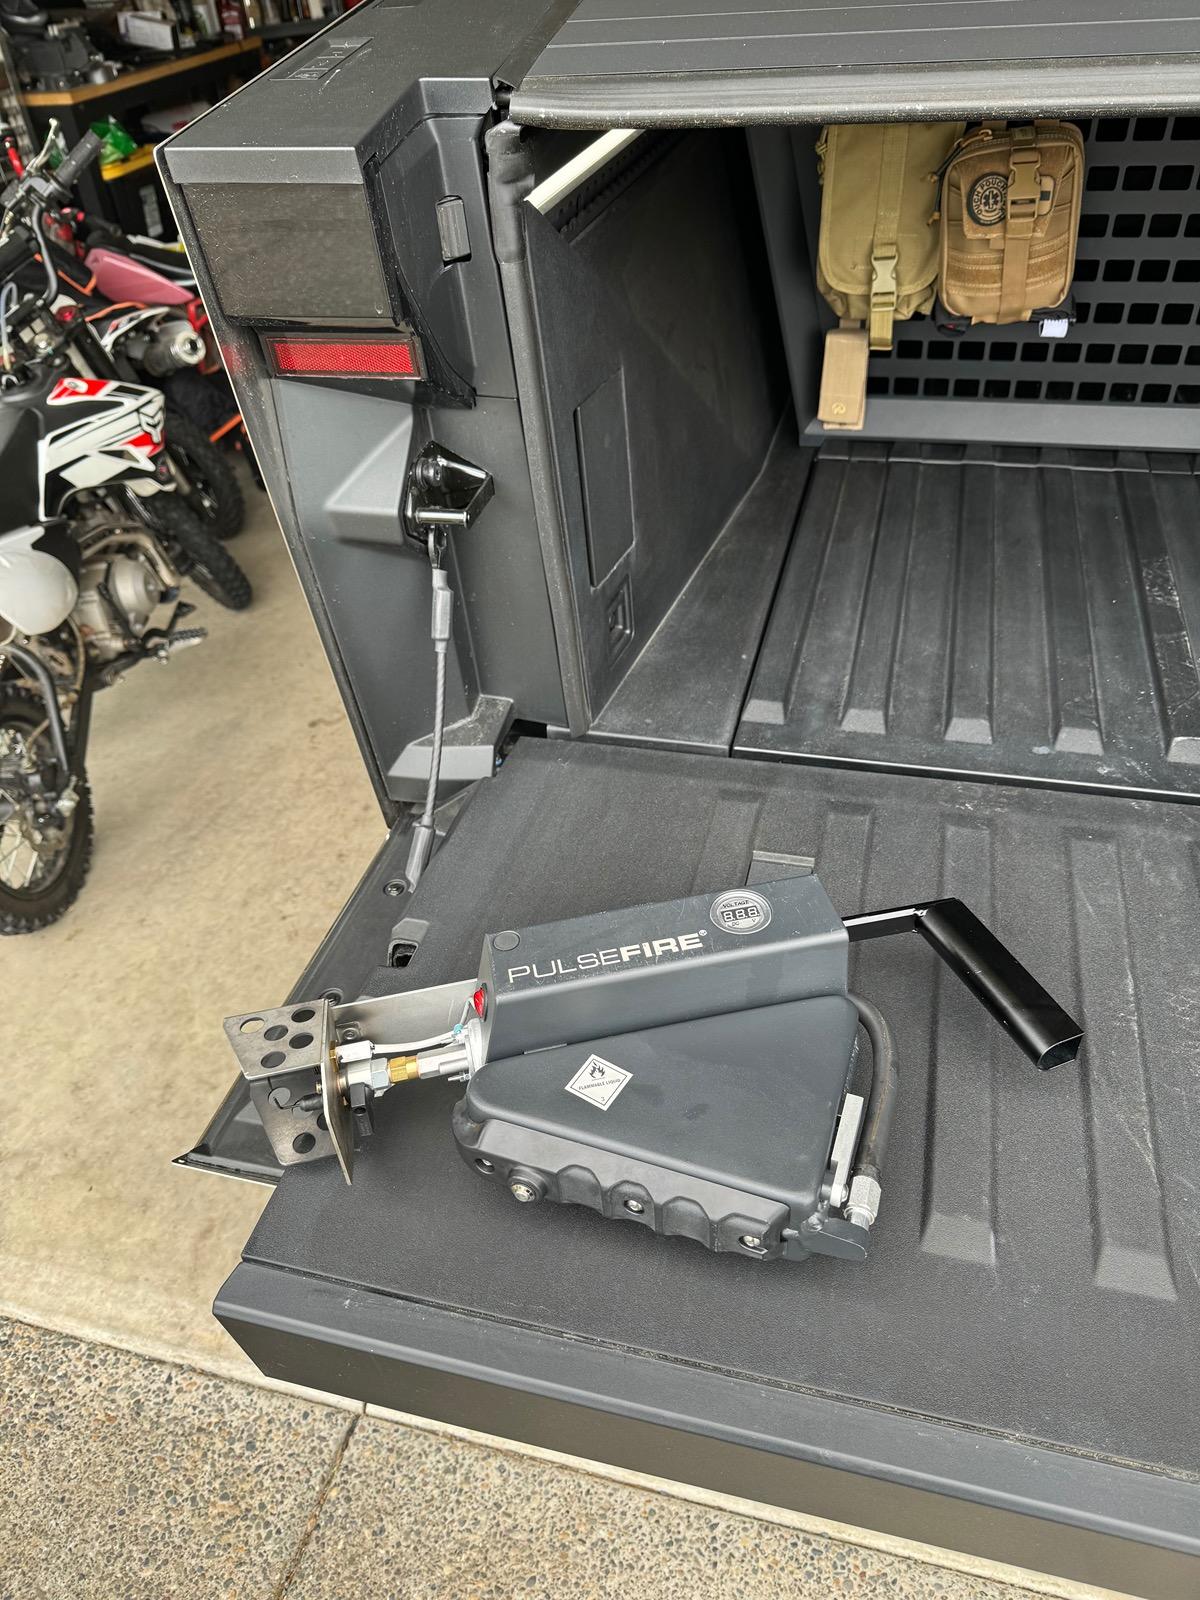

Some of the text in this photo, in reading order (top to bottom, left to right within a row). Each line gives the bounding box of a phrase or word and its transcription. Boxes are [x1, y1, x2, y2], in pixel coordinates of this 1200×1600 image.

[974, 190, 983, 215] OUCH
[980, 179, 1007, 191] POUCH
[722, 900, 749, 908] VOLTAGE
[579, 1081, 605, 1090] FLAMMABLE
